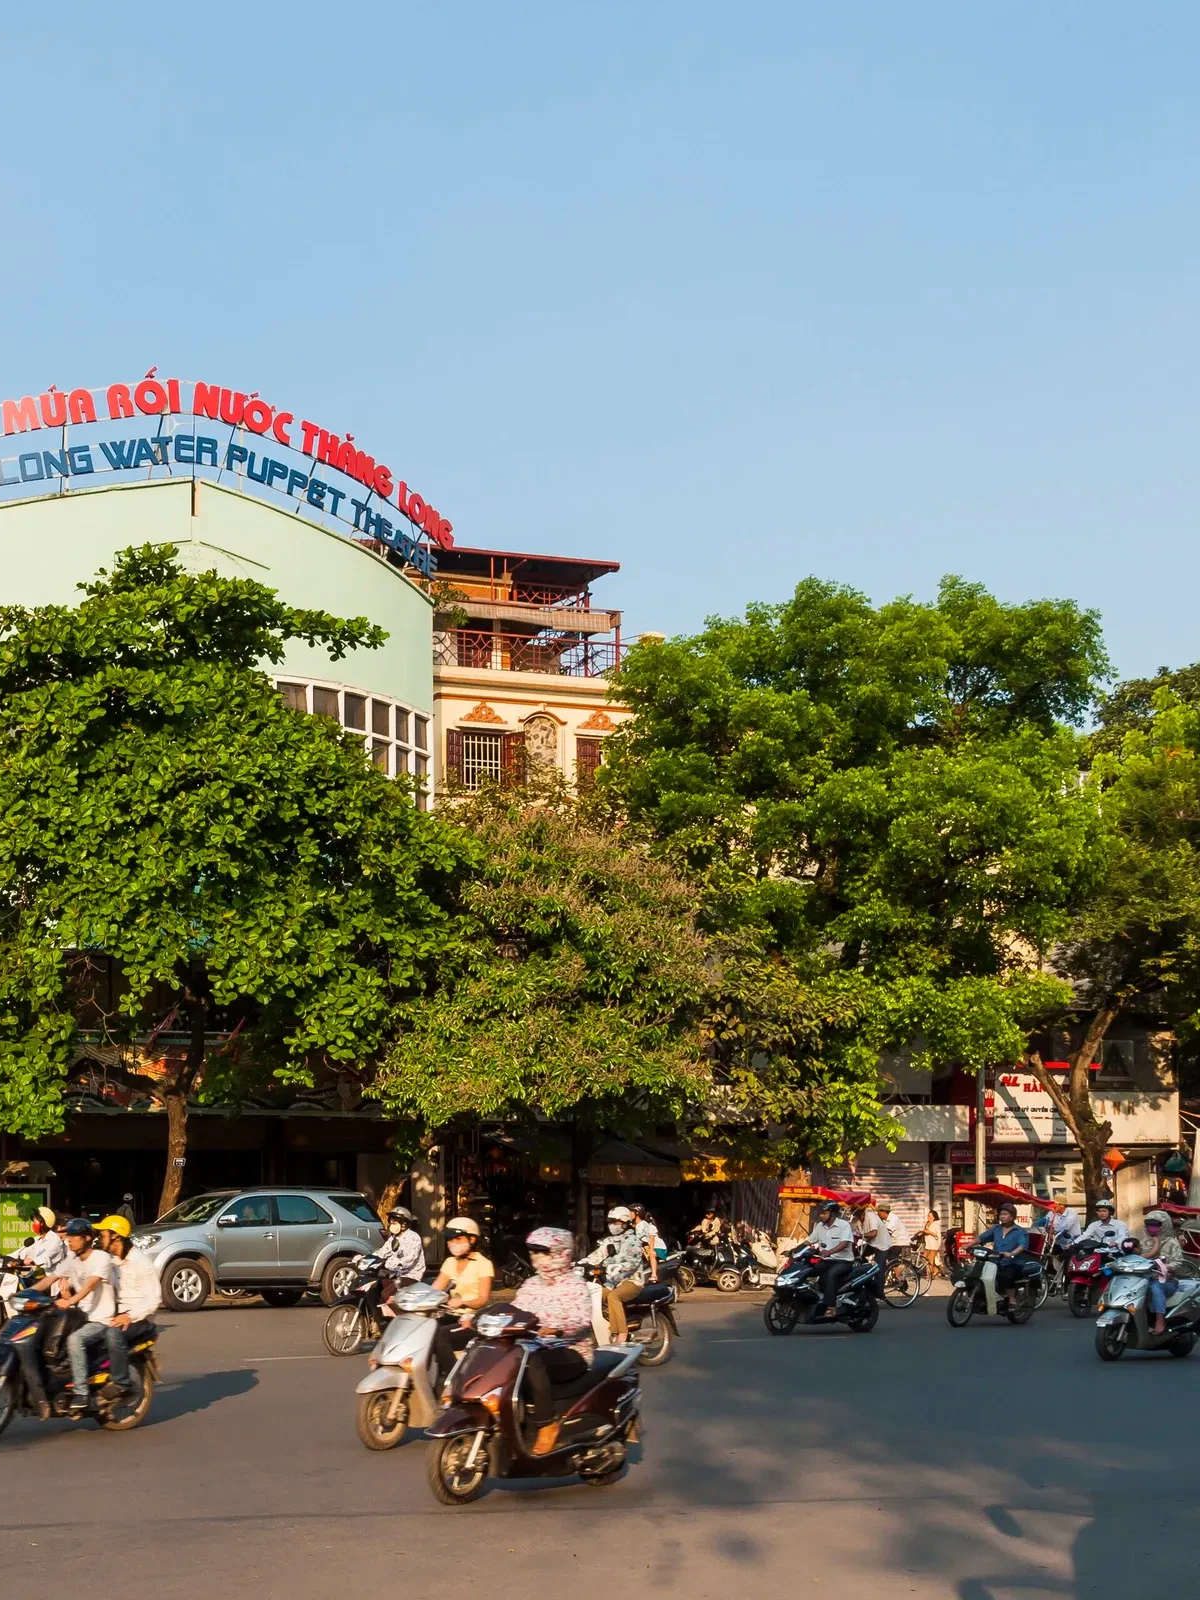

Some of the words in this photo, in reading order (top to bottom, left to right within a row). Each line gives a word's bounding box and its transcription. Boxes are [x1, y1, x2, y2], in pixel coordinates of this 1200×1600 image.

[2, 384, 98, 436] MÚA
[106, 365, 181, 420] RỐI
[192, 381, 296, 447] NƯỚC
[301, 420, 395, 500] THĂNG
[398, 480, 455, 551] LONG
[98, 434, 219, 471] WATER
[226, 443, 347, 516] PUPPET
[350, 497, 439, 580] THEATRE
